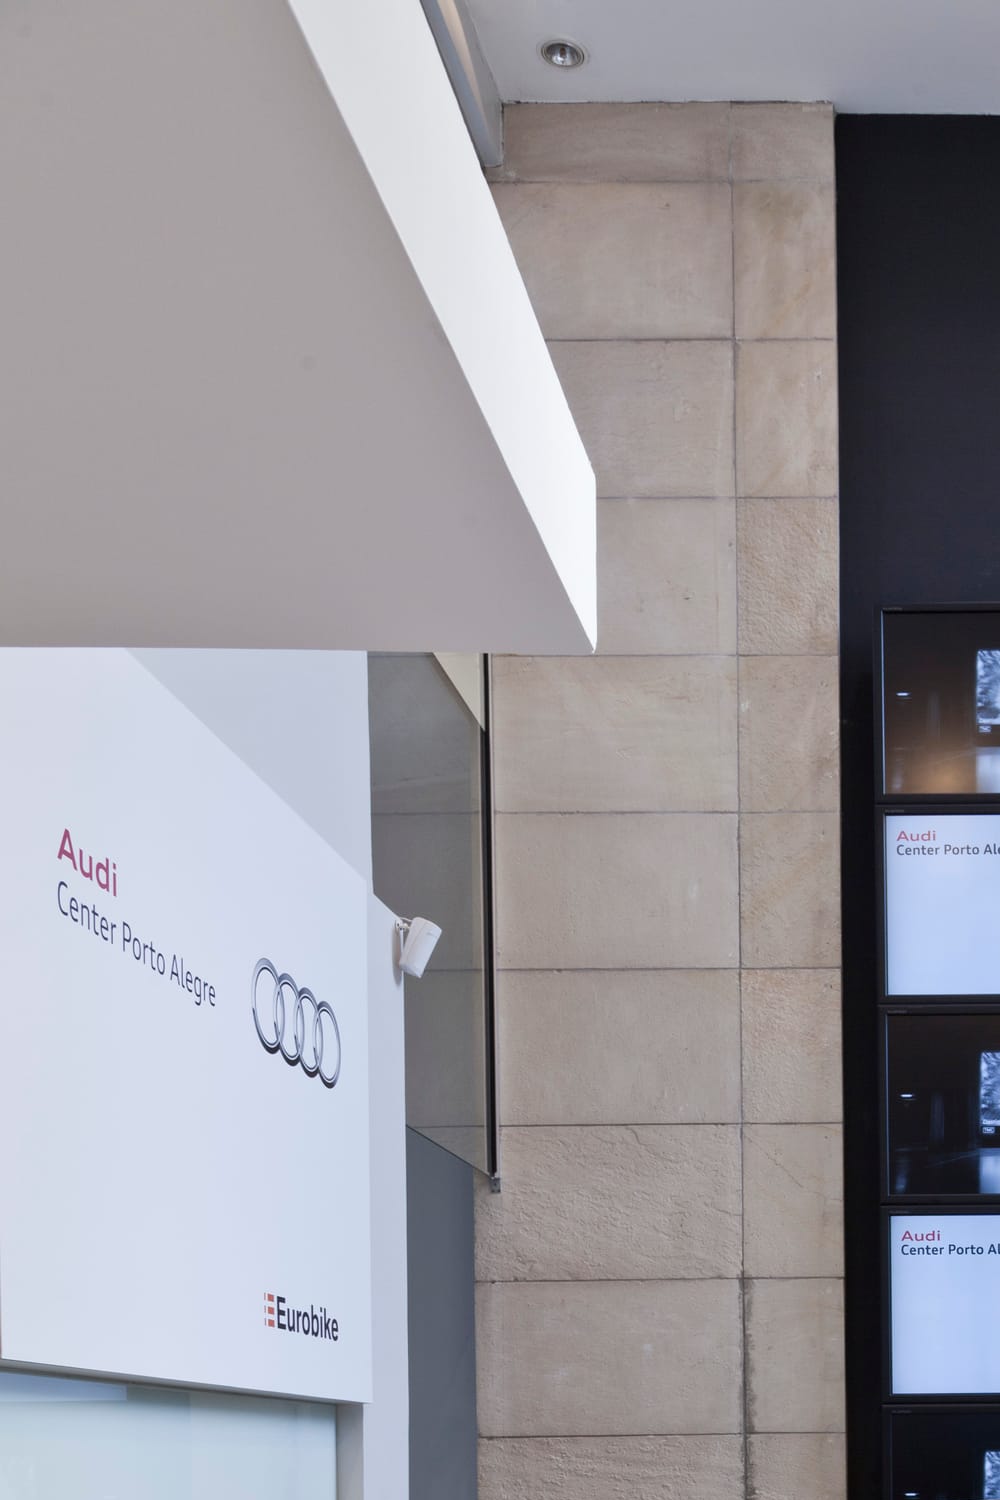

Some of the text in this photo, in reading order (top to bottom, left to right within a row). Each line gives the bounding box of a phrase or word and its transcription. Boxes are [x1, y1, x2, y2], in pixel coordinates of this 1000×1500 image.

[896, 830, 937, 842] Audi
[896, 843, 941, 857] Center
[943, 843, 980, 857] Porto
[57, 828, 117, 897] Audi
[57, 881, 216, 1007] Center Porto Alegre
[901, 1230, 941, 1242] Audi
[901, 1243, 945, 1256] Center
[948, 1243, 985, 1256] Porto
[277, 1295, 339, 1341] Eurobike
